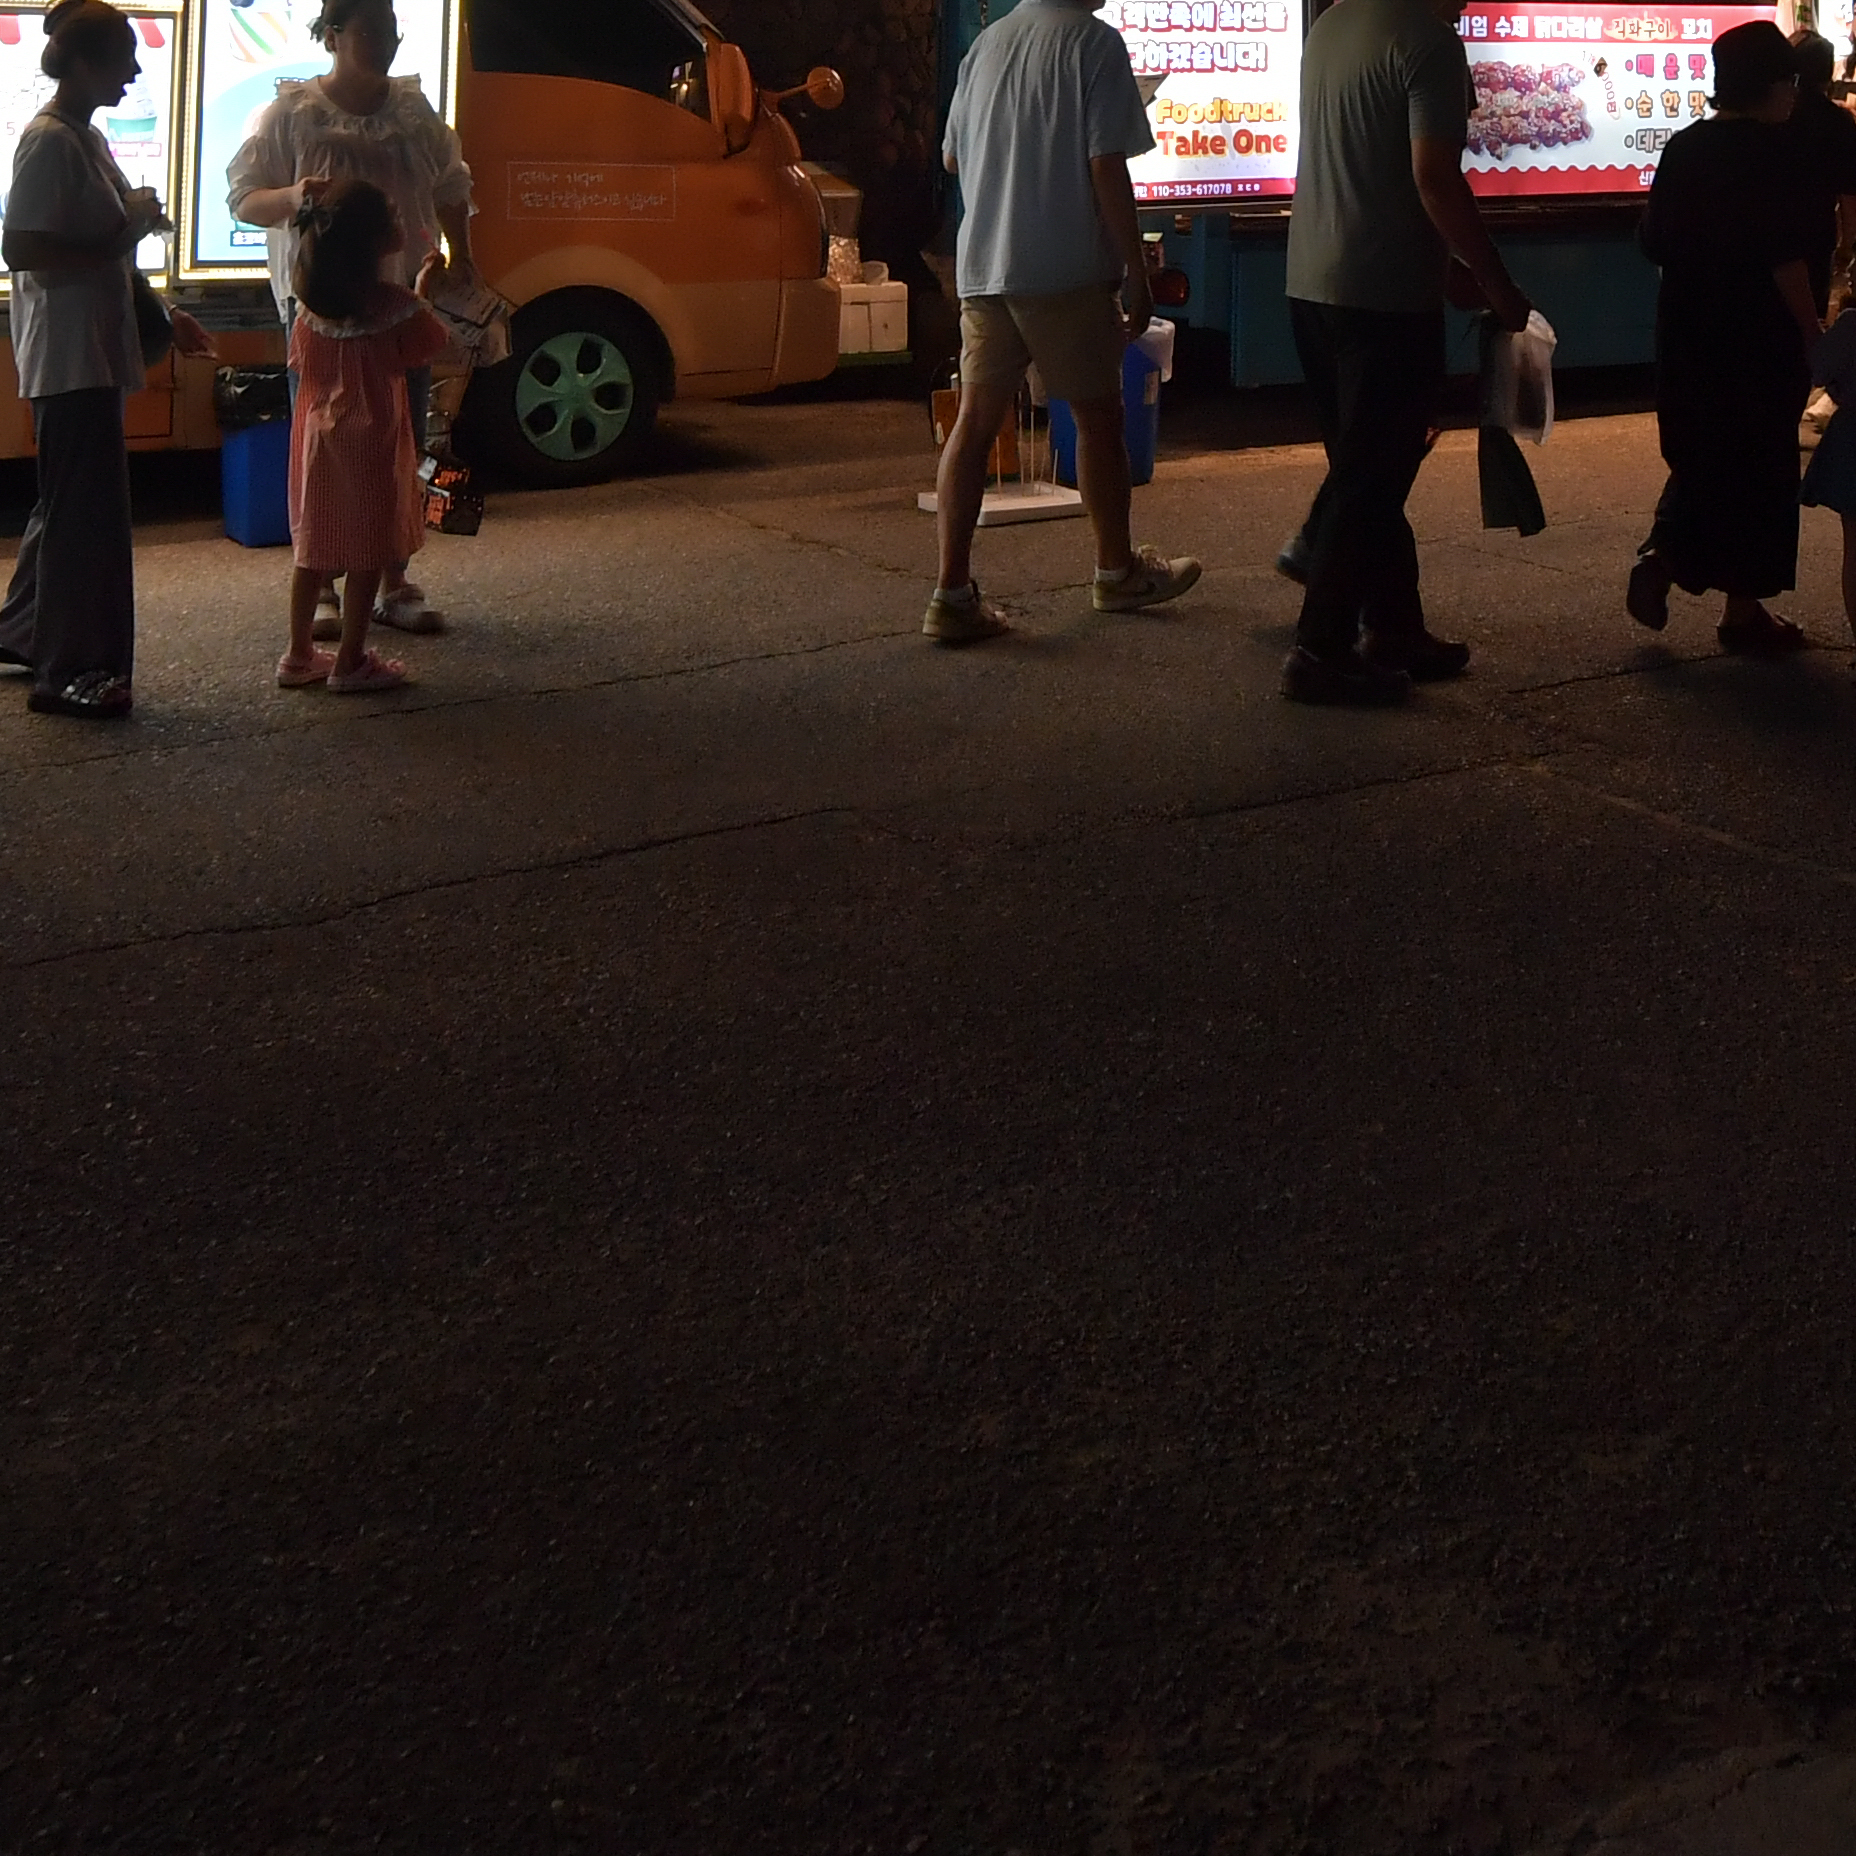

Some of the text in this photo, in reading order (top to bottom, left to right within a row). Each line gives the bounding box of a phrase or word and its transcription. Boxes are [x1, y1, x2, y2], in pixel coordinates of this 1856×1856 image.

[1494, 15, 1529, 38] 수제
[1534, 15, 1604, 39] 닭다리살
[1612, 17, 1672, 39] 직화구이
[1155, 97, 1288, 124] Foodtruck
[1156, 129, 1288, 158] Take One
[1635, 128, 1675, 154] 데리
[1151, 183, 1232, 198] 110-353-617078
